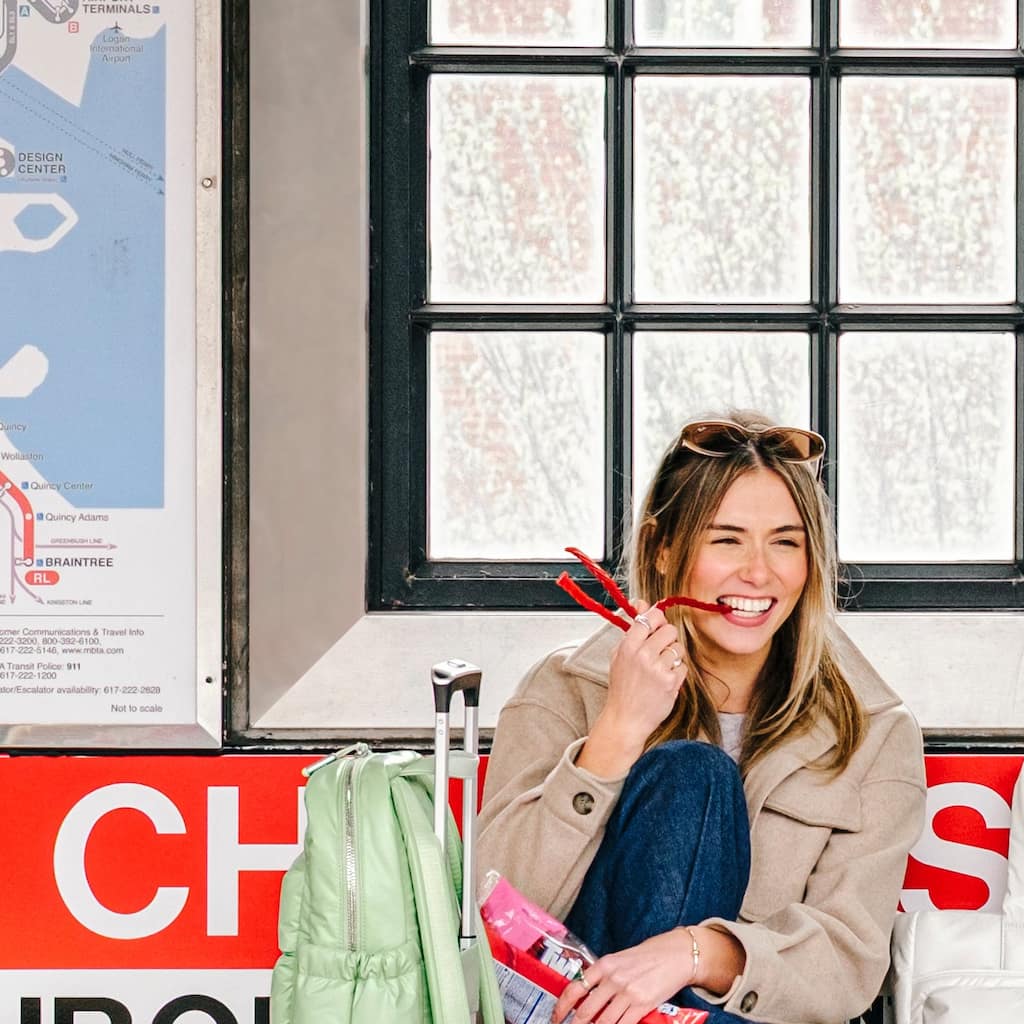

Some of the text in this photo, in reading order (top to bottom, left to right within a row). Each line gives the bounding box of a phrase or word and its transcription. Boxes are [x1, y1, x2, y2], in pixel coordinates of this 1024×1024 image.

[82, 4, 151, 14] TERMINALS
[103, 35, 130, 43] Logan
[102, 54, 131, 63] Airport
[18, 152, 63, 162] DESIGN
[18, 164, 66, 174] CENTER
[1, 452, 44, 461] Wollaston
[30, 481, 93, 491] Quincy Center
[45, 513, 109, 522] Quincy Adams
[45, 557, 114, 568] BRAINTREE
[33, 573, 51, 584] RL
[22, 628, 91, 636] Communications
[92, 628, 99, 636] &
[102, 628, 127, 636] Travel
[129, 628, 145, 636] Info
[62, 647, 124, 655] www.mbta.com
[7, 662, 35, 670] Transit
[37, 662, 63, 670] Police:
[66, 662, 81, 670] 911
[110, 704, 163, 713] Not to scale
